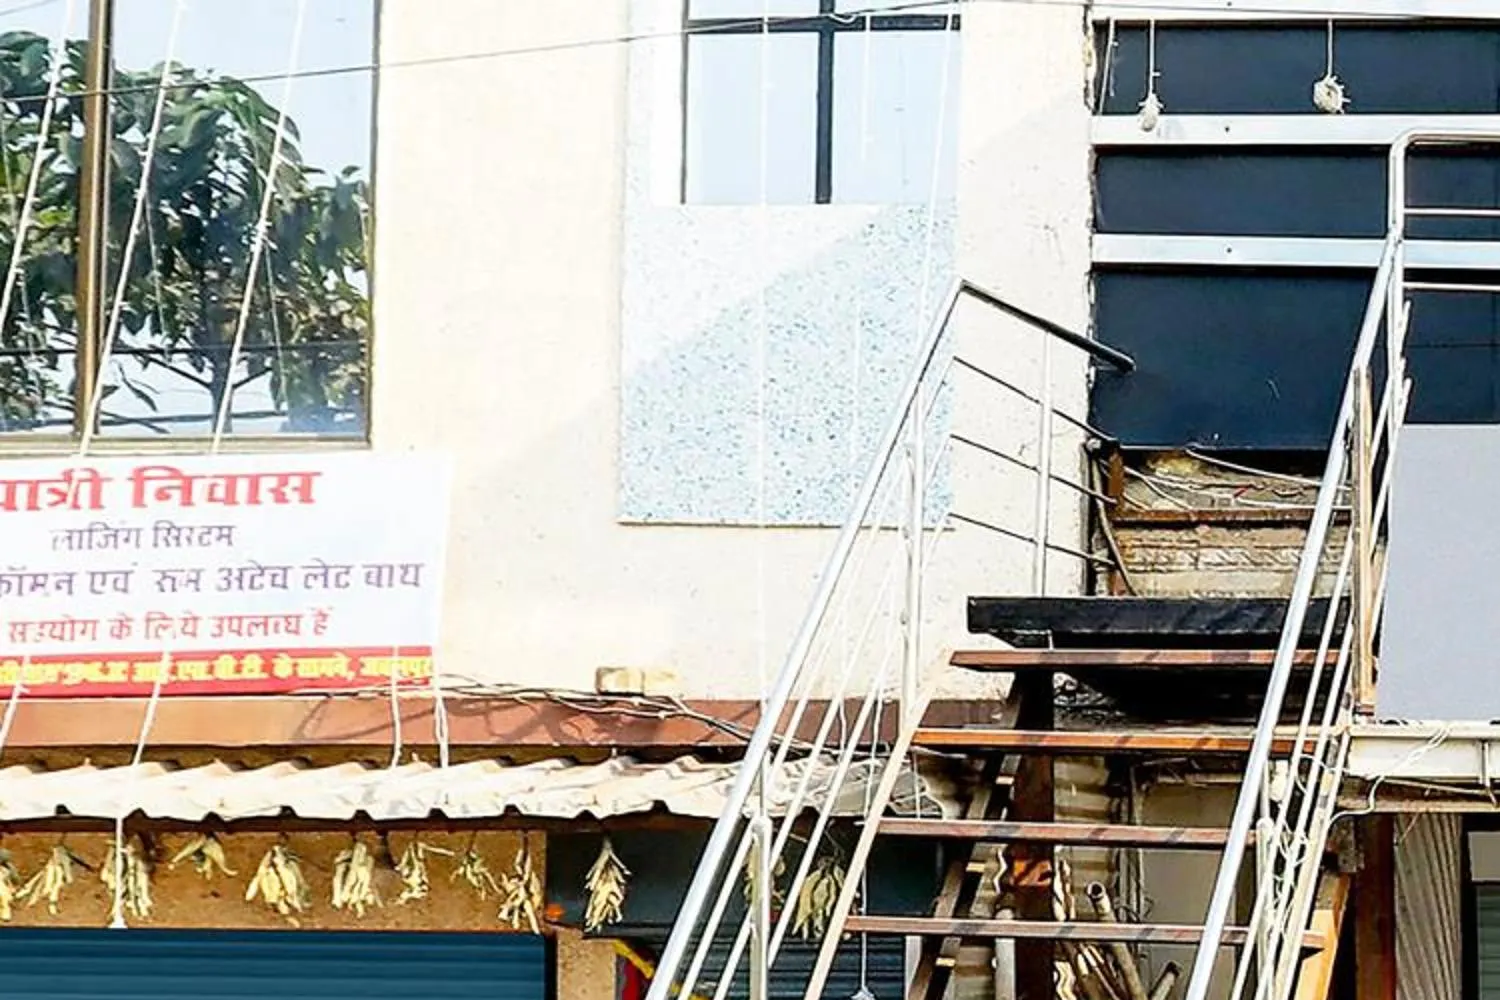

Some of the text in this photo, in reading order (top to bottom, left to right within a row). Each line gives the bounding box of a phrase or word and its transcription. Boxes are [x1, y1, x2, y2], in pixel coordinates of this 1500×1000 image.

[127, 465, 320, 508] निवास
[87, 561, 138, 594] एवं
[214, 559, 292, 592] अटेच
[301, 557, 354, 590] लेट
[107, 612, 134, 640] के
